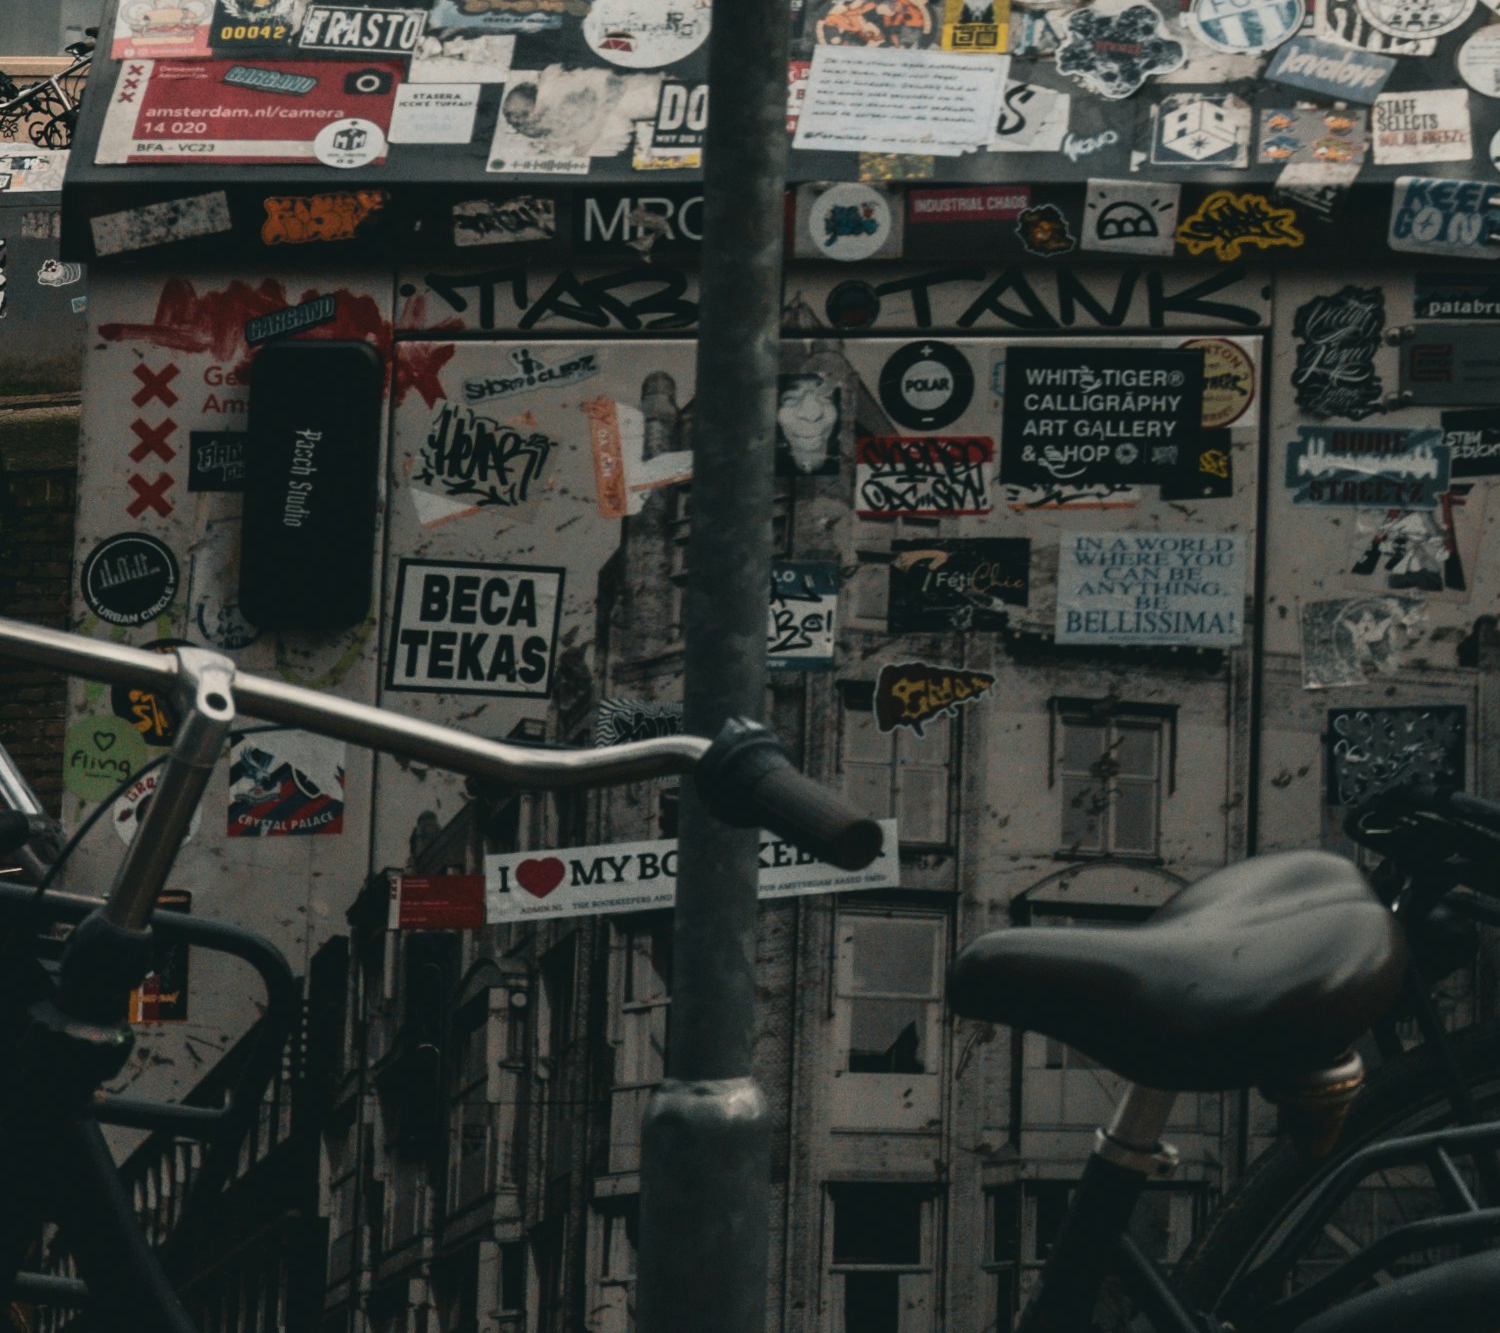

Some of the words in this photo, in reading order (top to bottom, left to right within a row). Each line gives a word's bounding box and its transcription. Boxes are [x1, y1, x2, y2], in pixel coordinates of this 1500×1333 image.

[221, 25, 286, 41] 00042
[306, 8, 420, 49] TRASTO
[145, 105, 344, 119] amsterdam.nl/camera
[1376, 99, 1417, 115] STAFF
[144, 122, 165, 134] 14
[172, 122, 207, 134] 020
[1378, 114, 1439, 132] SELECTS
[136, 143, 165, 152] BFA
[179, 143, 215, 153] VC23
[914, 196, 984, 215] INDUSTRIAL
[986, 195, 1028, 213] CHAOS
[905, 377, 949, 393] POLAR
[1022, 420, 1068, 437] ART
[1073, 420, 1177, 441] GALLERY
[1021, 445, 1037, 462] &
[1076, 537, 1102, 551] IN
[1108, 537, 1126, 551] A
[1134, 537, 1234, 551] WORLD
[1076, 552, 1169, 566] WHERE
[1176, 552, 1235, 566] YOU
[1103, 568, 1159, 581] CAN
[1168, 568, 1202, 580] BE
[97, 602, 139, 624] URBAN
[140, 584, 175, 622] CIRCLE
[419, 573, 537, 628] BECA
[1135, 597, 1169, 610] BE
[1066, 611, 1235, 633] BELLISSIMA!
[400, 630, 549, 685] TEKAS
[238, 812, 289, 833] CRYSTAL
[290, 811, 335, 831] PALACE
[499, 866, 509, 894] I
[570, 855, 637, 887] MY
